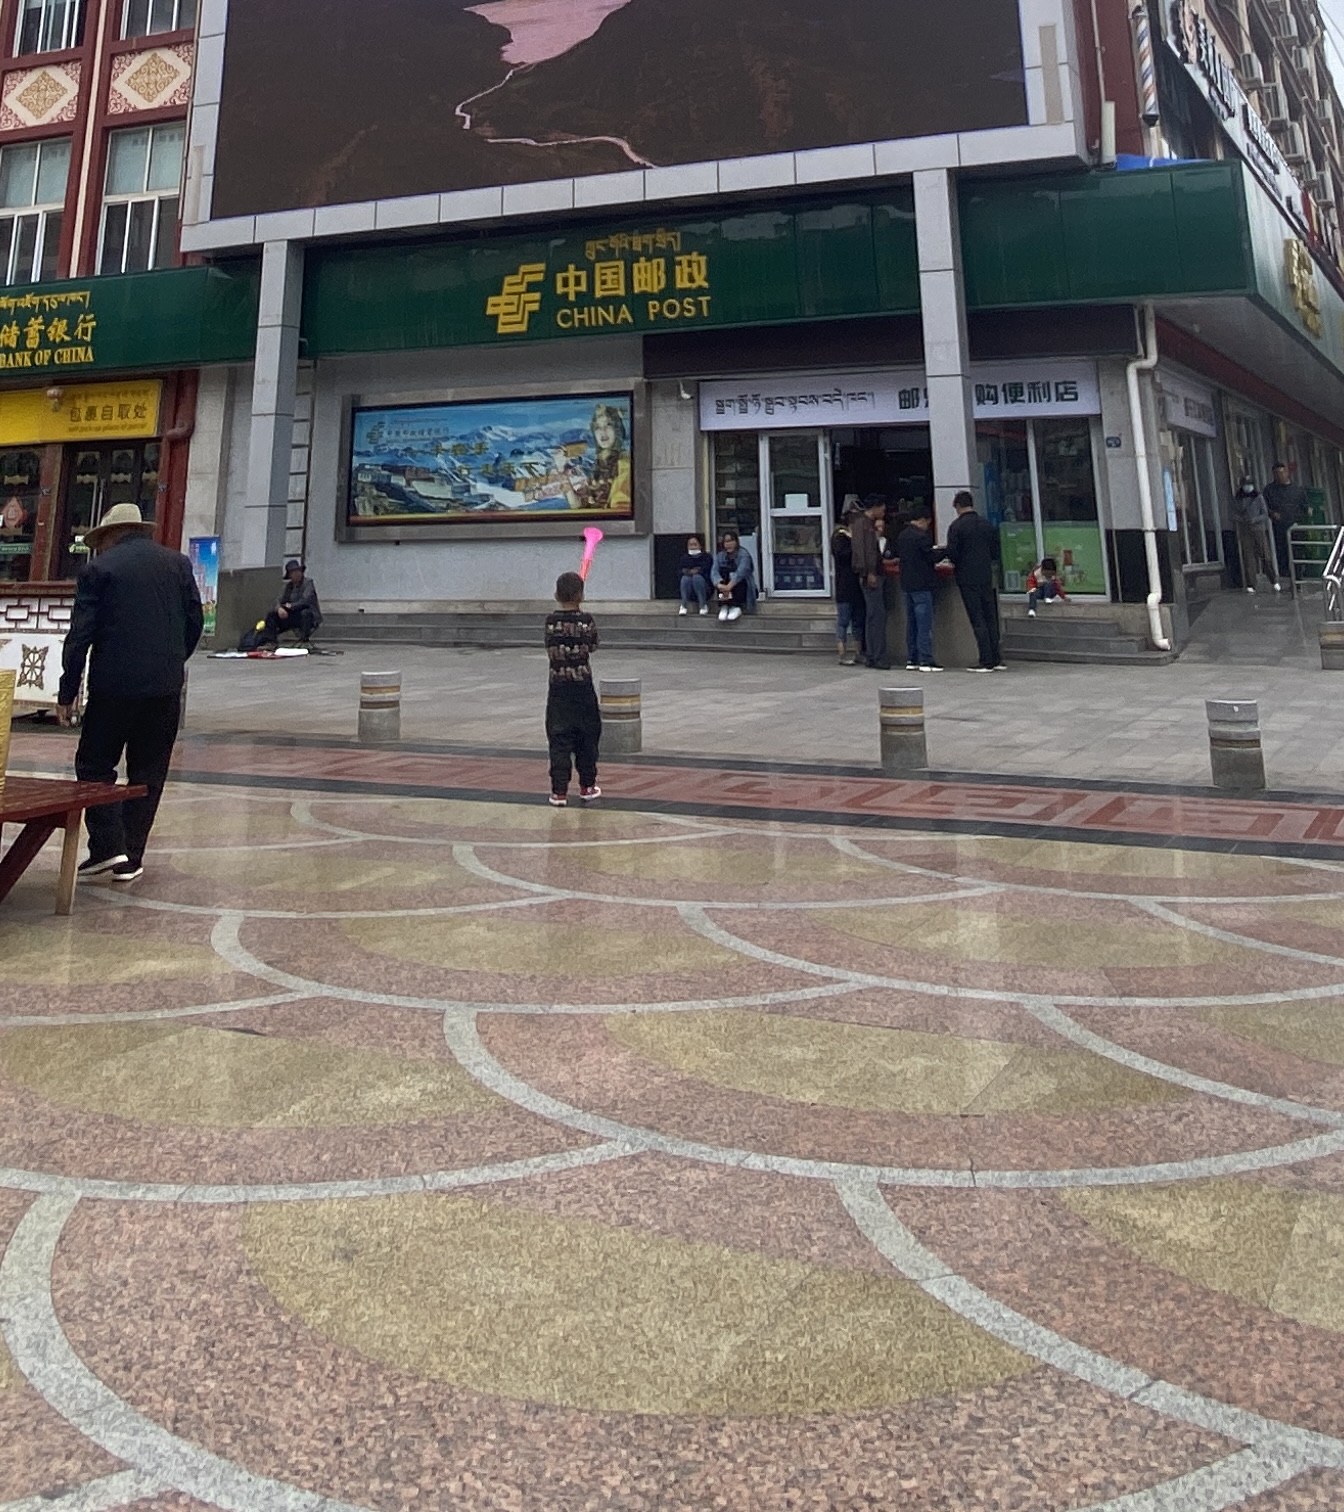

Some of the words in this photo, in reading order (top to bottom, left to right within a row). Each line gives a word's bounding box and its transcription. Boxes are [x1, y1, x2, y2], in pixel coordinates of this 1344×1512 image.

[556, 251, 709, 302] 中国邮政
[556, 304, 634, 329] CHINA
[648, 296, 712, 321] POST
[34, 348, 52, 365] OF
[54, 345, 94, 365] CHINA
